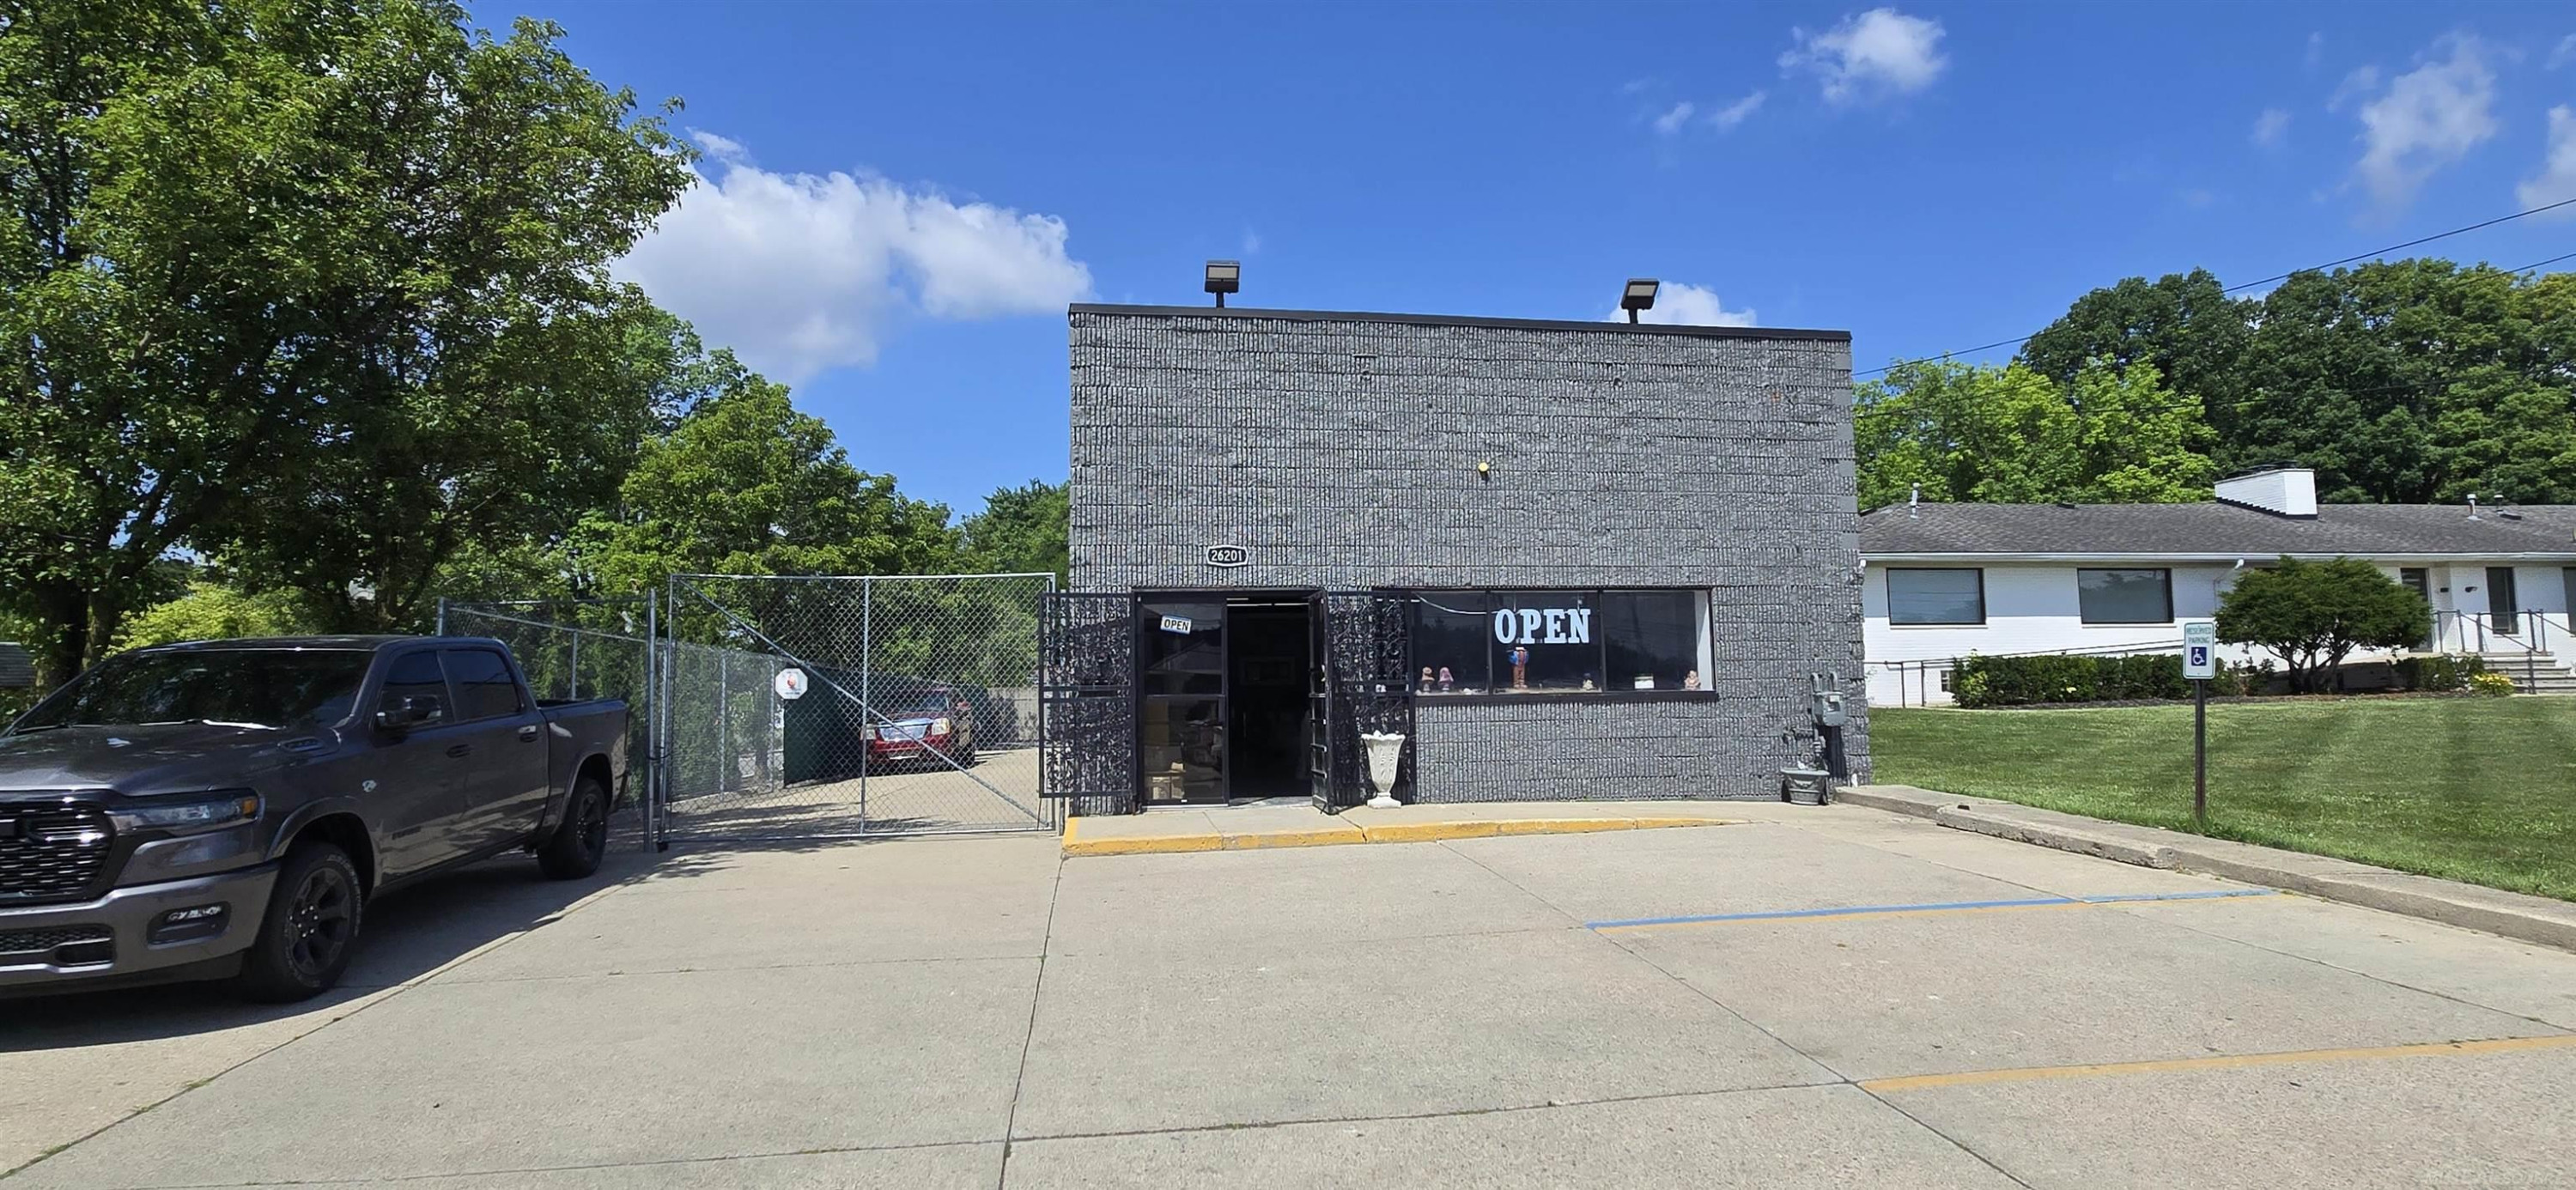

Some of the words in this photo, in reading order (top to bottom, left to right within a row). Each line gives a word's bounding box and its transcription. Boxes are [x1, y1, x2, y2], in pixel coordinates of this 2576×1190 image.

[1211, 549, 1242, 562] 26201
[1163, 618, 1189, 631] OPEN
[1495, 609, 1591, 644] OPEN
